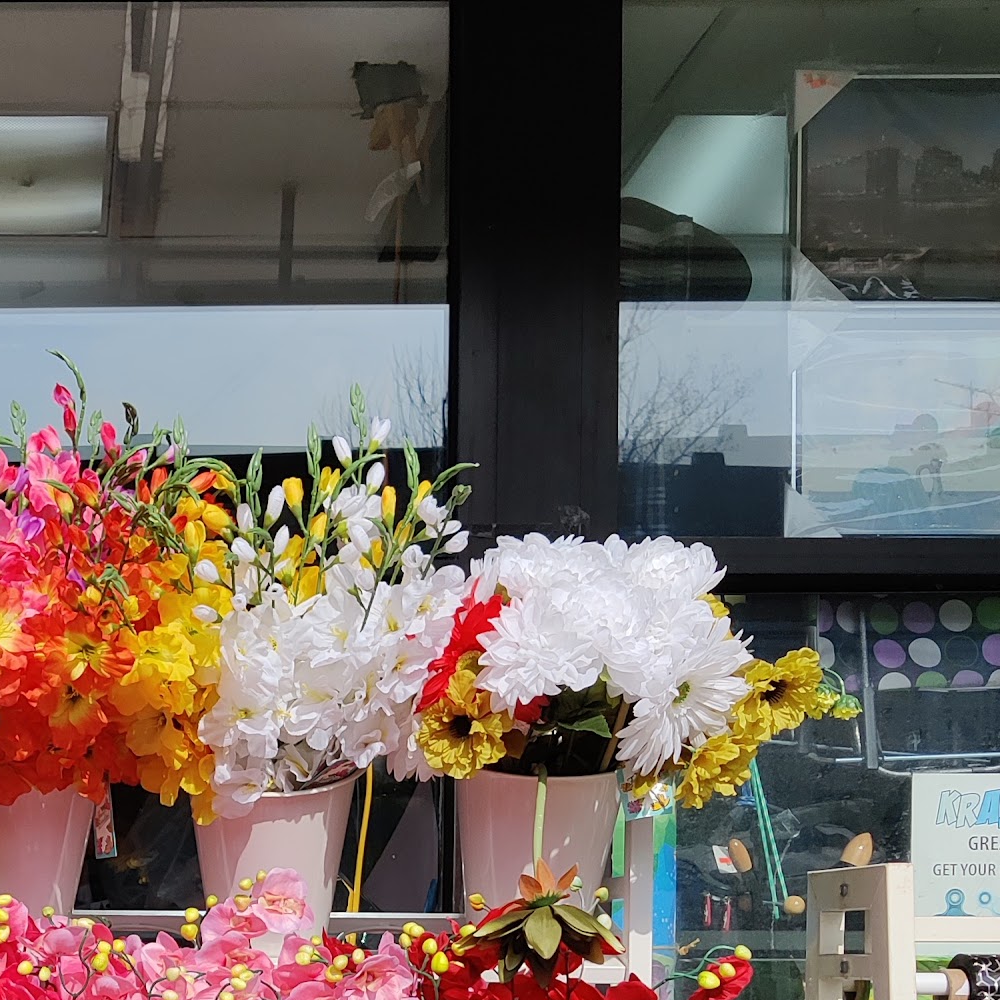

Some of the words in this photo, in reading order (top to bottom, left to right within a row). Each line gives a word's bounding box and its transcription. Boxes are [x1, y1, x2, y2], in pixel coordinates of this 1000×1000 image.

[935, 789, 1000, 829] KRA
[968, 836, 1000, 851] GRE
[932, 863, 958, 877] GET
[960, 863, 997, 877] YOUR
